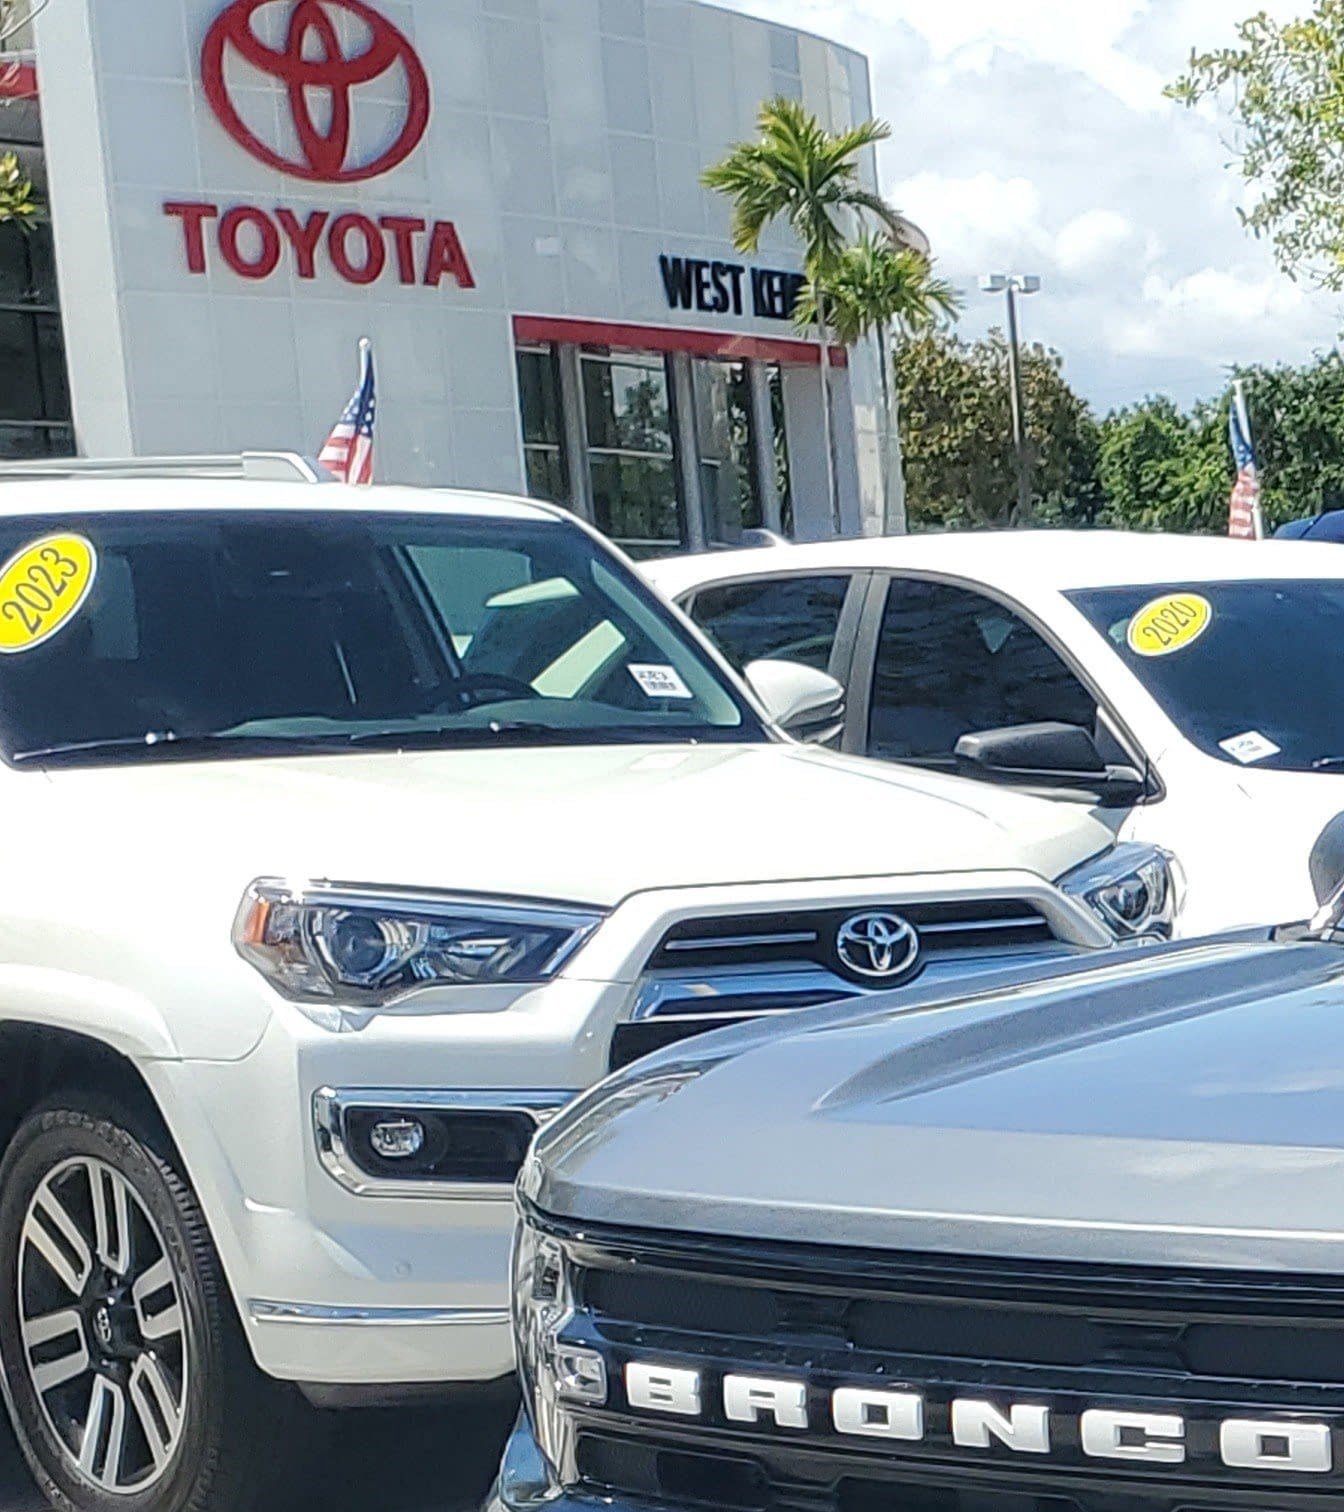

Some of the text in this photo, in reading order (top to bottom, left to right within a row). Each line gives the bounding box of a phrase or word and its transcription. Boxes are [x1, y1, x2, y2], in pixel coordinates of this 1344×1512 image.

[162, 201, 476, 289] TOYOTA
[659, 254, 745, 316] WEST
[2, 547, 78, 635] 2023
[1142, 601, 1197, 646] 2020
[625, 1361, 1333, 1473] BRONCO
